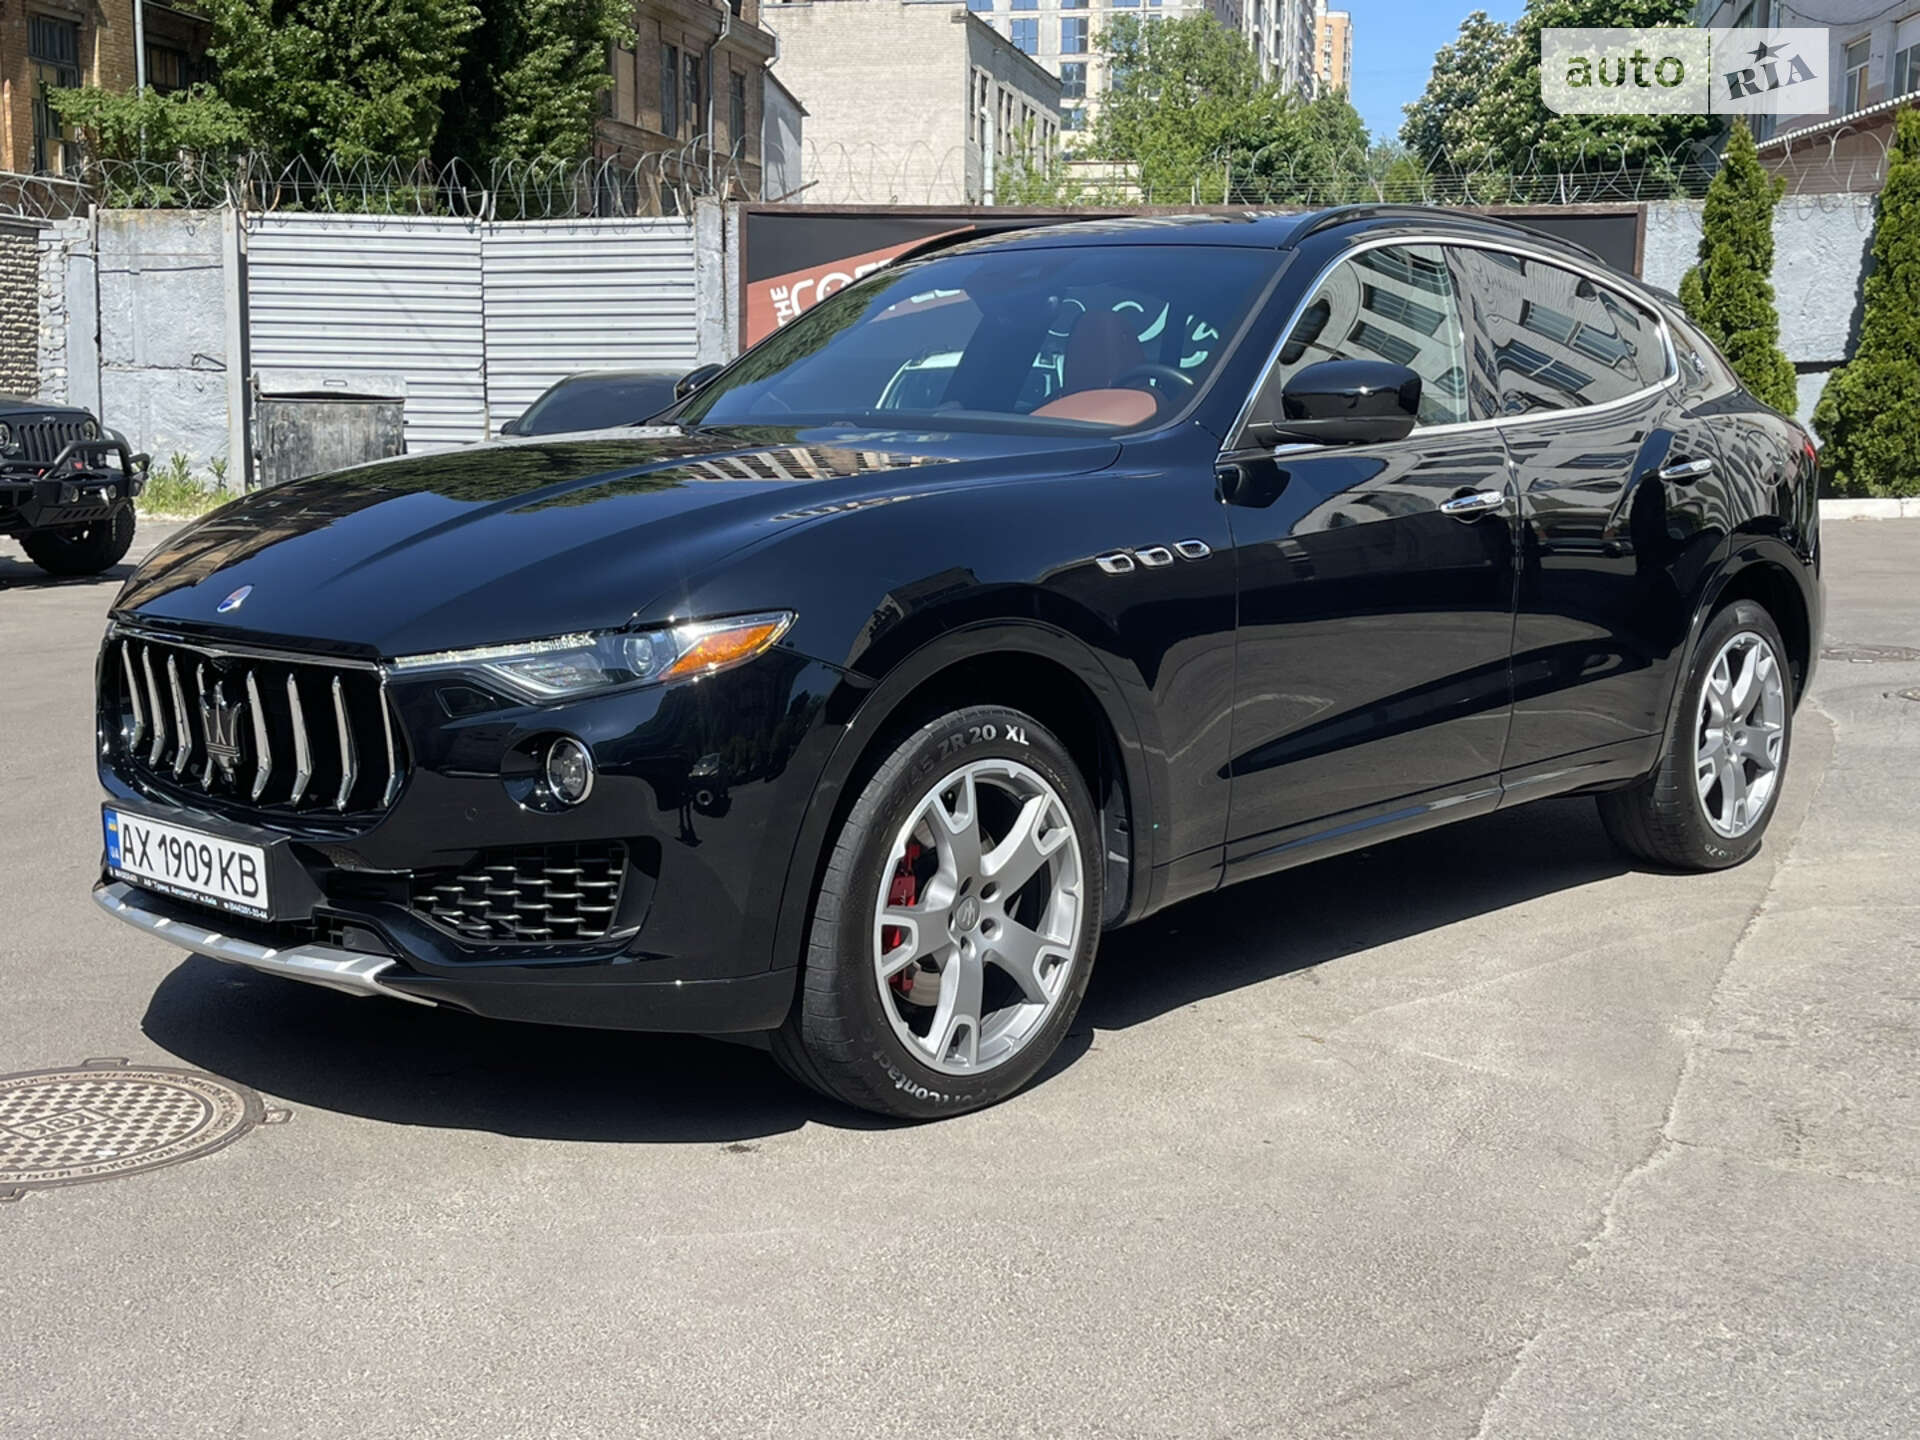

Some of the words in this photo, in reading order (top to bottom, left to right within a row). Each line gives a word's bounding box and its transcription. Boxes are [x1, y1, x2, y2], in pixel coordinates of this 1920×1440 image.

[969, 724, 997, 745] 20
[1005, 724, 1031, 746] XL
[123, 824, 154, 871] AX
[158, 833, 213, 886] 1909
[218, 848, 259, 898] KB
